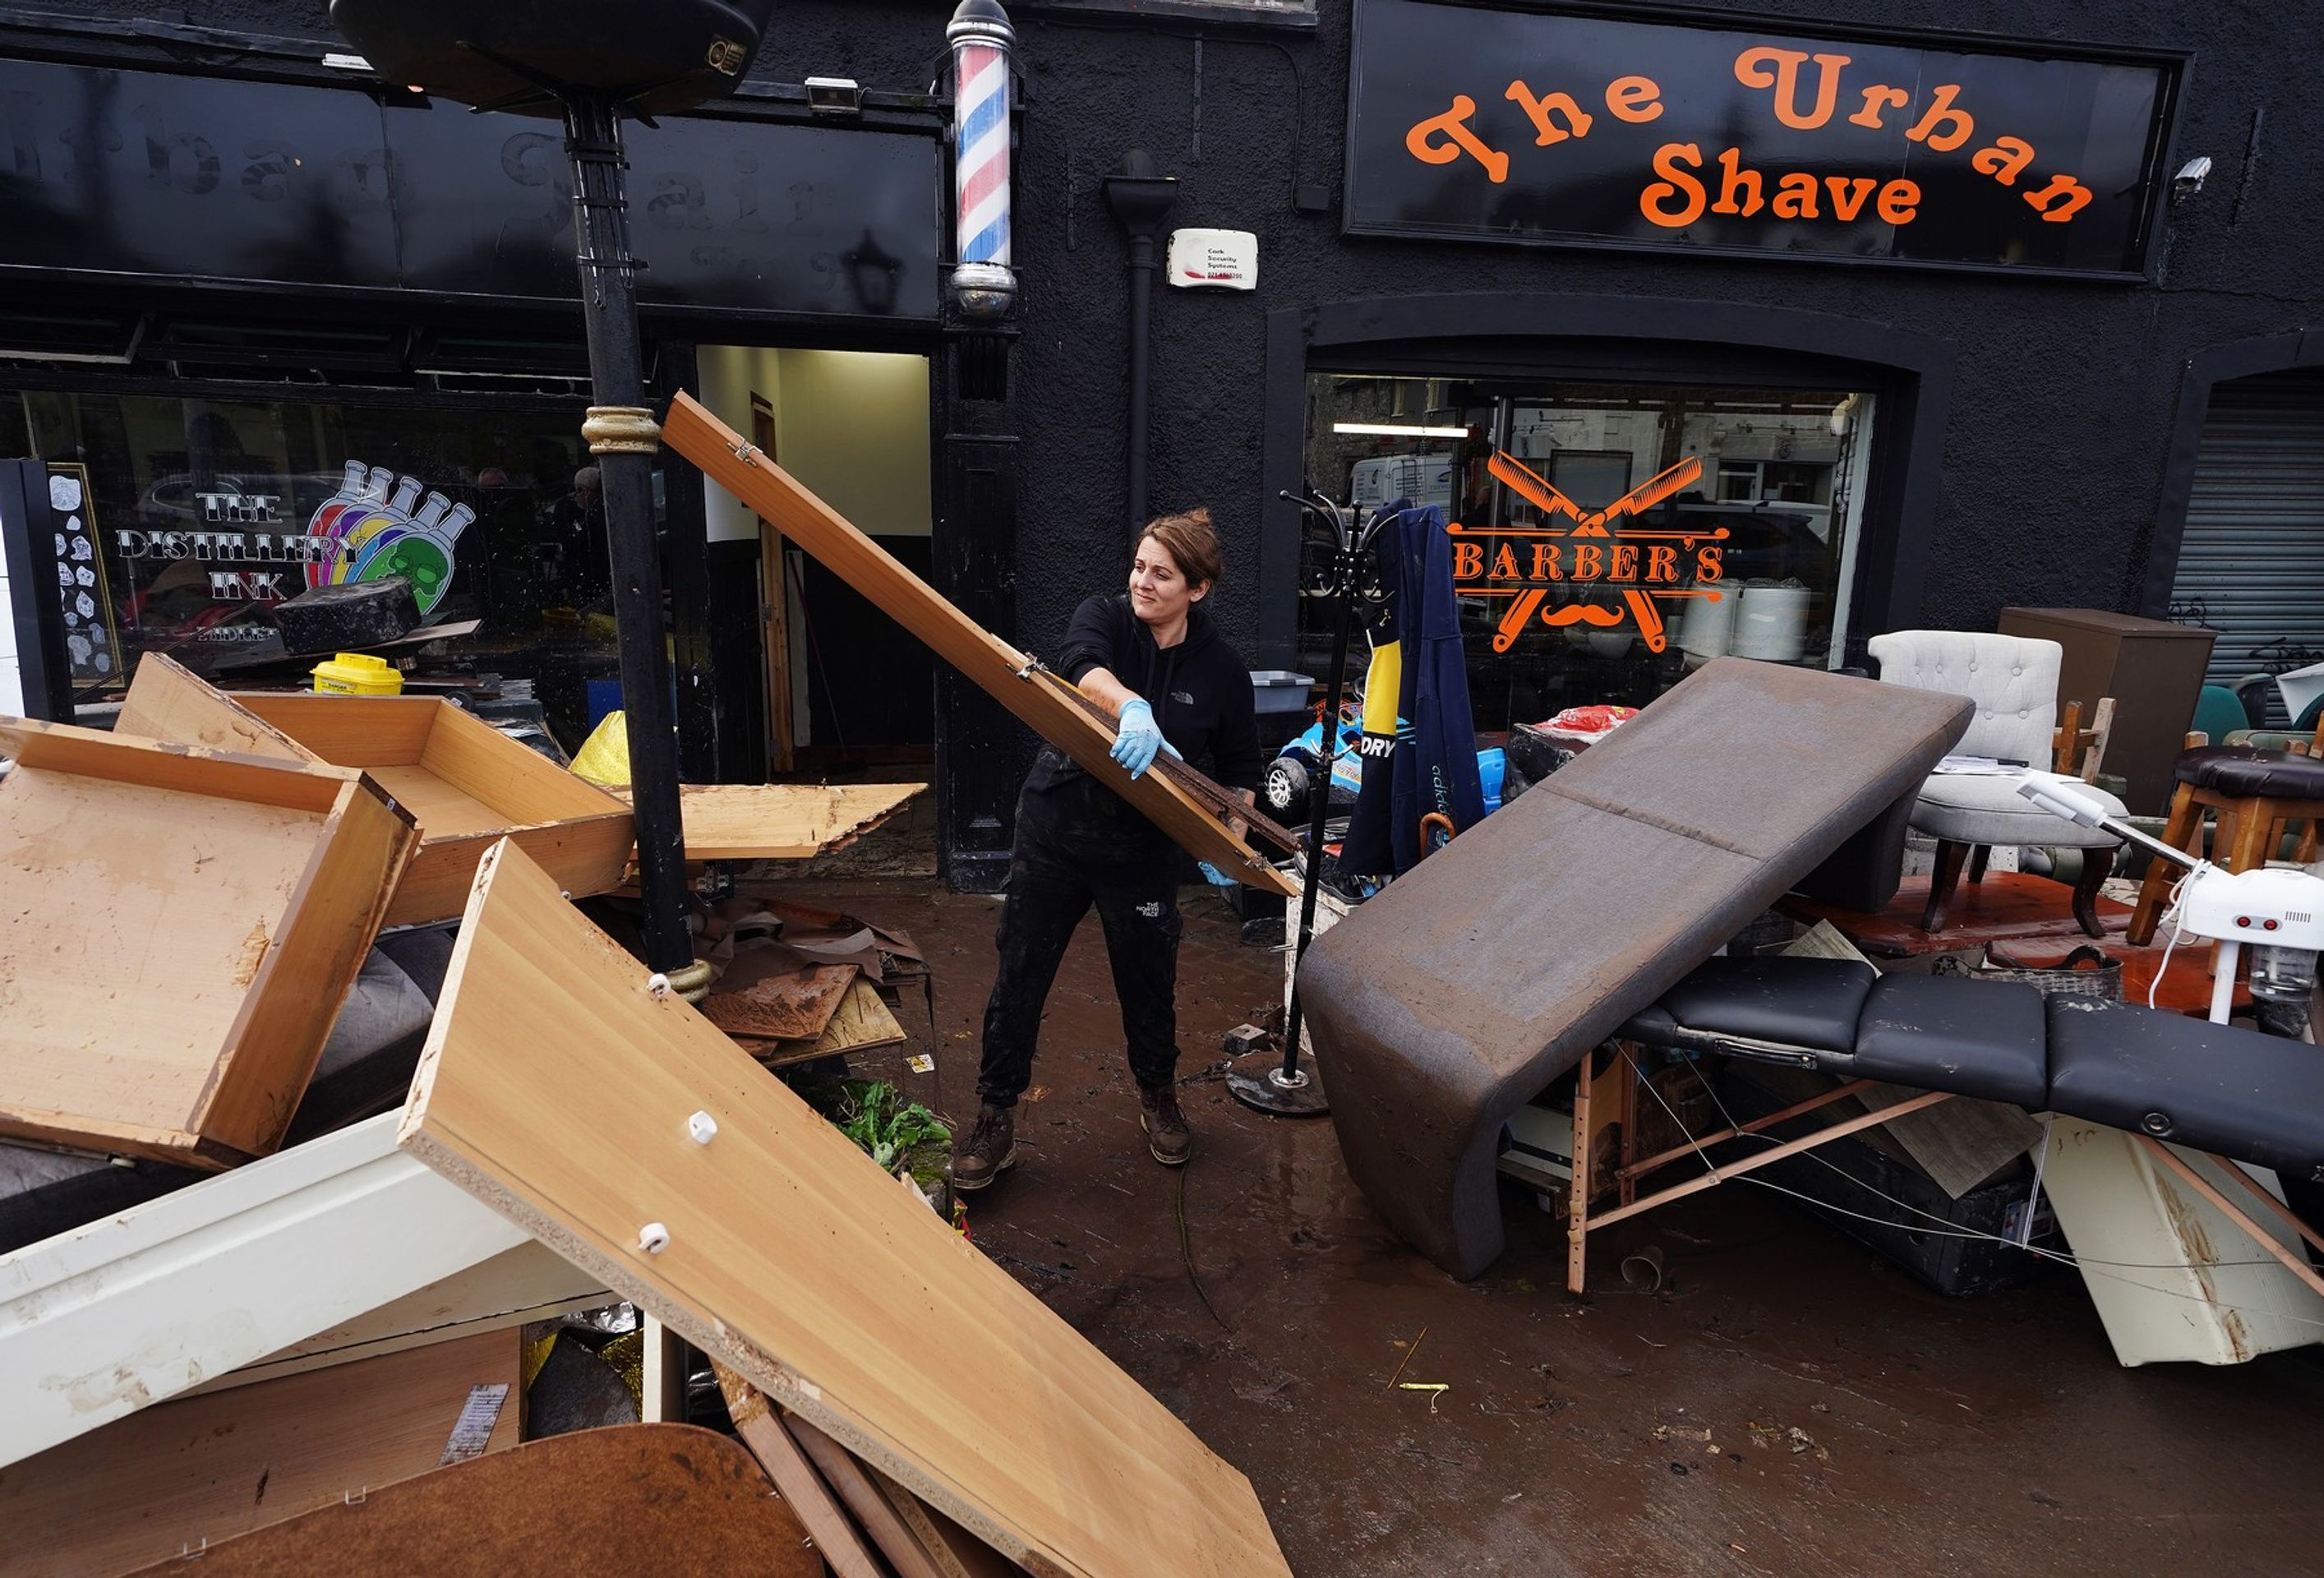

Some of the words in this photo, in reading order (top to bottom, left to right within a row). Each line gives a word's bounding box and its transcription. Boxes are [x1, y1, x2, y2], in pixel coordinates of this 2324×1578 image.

[1406, 76, 1663, 183] The
[1734, 46, 2094, 223] Urban
[1639, 142, 1922, 228] Shave
[196, 493, 282, 523] THE
[116, 529, 362, 564] DISTILLERY
[1453, 535, 1723, 583] BARBER'S
[208, 571, 288, 601] INK
[1360, 736, 1396, 758] DRY
[1432, 764, 1450, 816] adida
